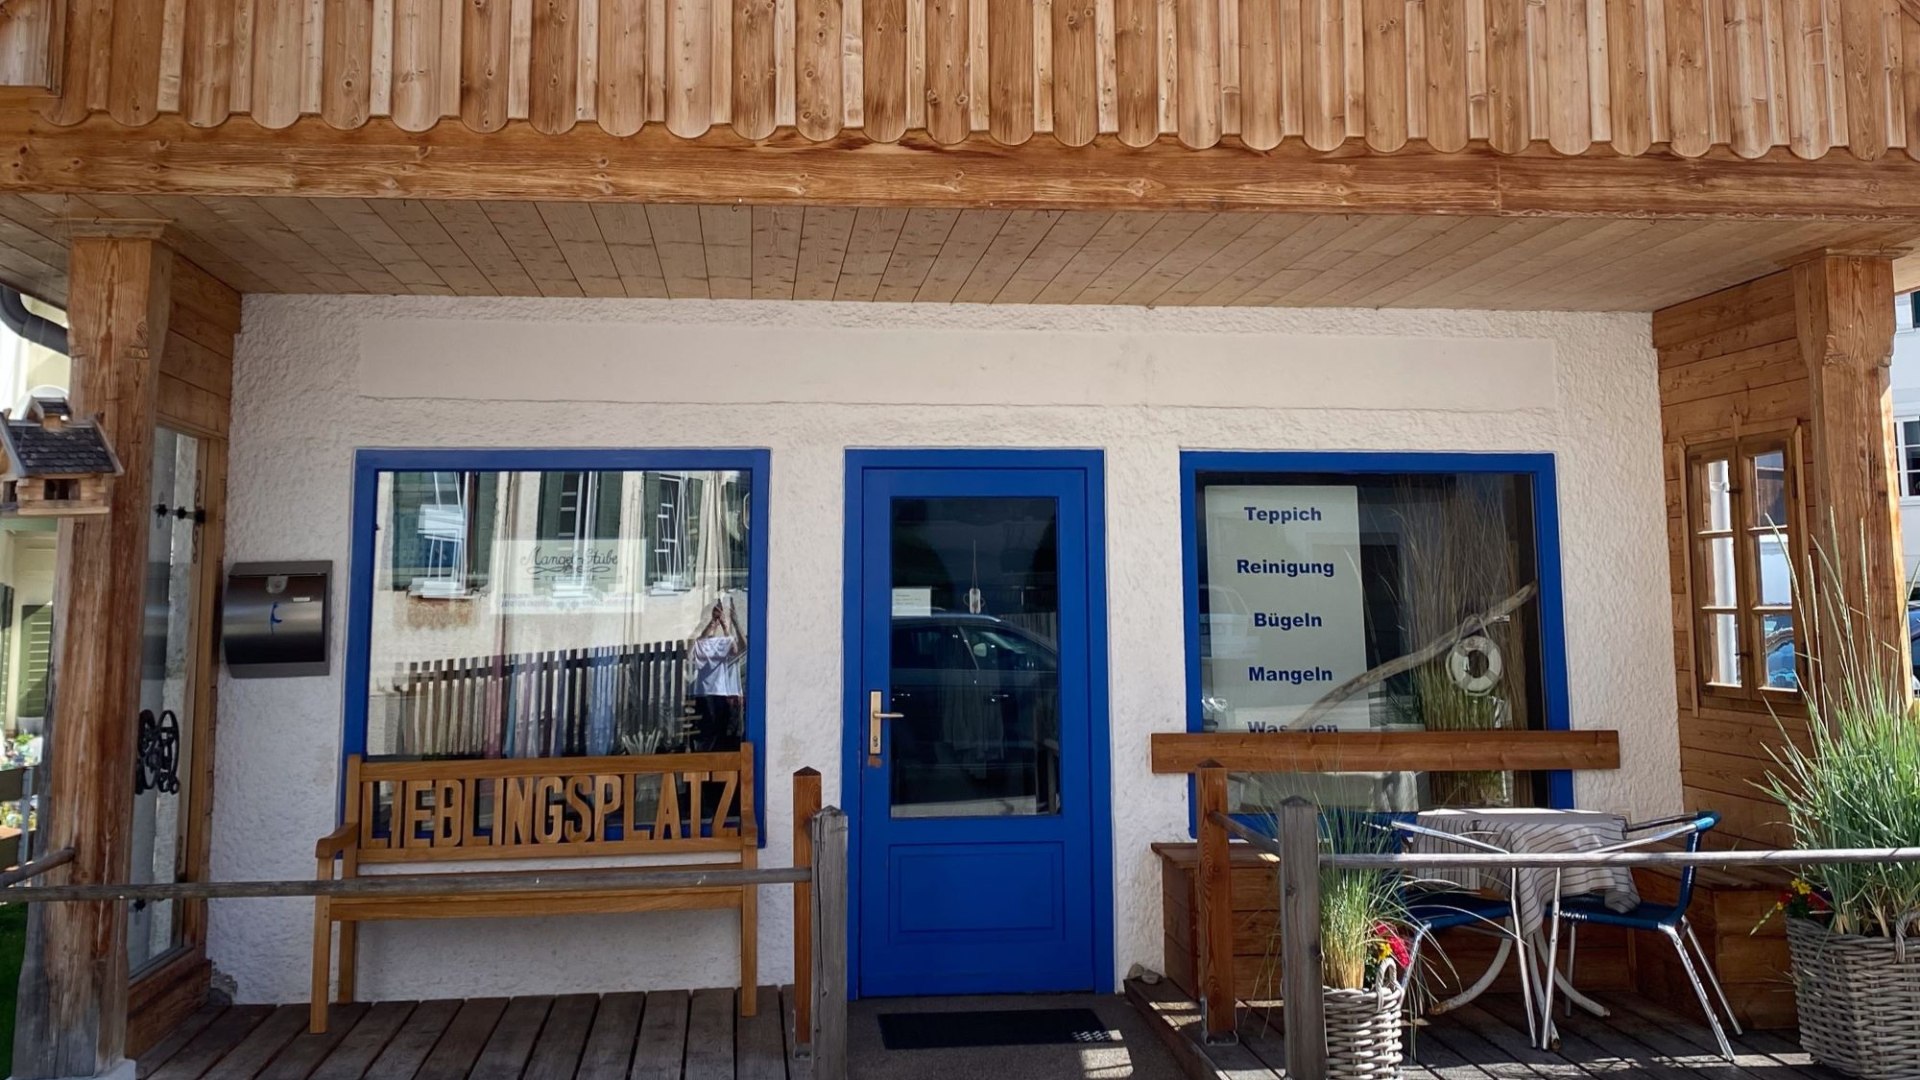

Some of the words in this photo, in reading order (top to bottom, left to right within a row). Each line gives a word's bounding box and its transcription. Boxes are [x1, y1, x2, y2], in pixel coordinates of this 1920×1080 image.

[1244, 506, 1321, 523] Teppich
[1237, 559, 1334, 577] Reinigung
[1254, 612, 1322, 630] Bügeln
[1248, 666, 1333, 684] Mangeln
[1248, 721, 1338, 733] Wasen
[361, 771, 738, 848] LIEBLINGSPLATZ
